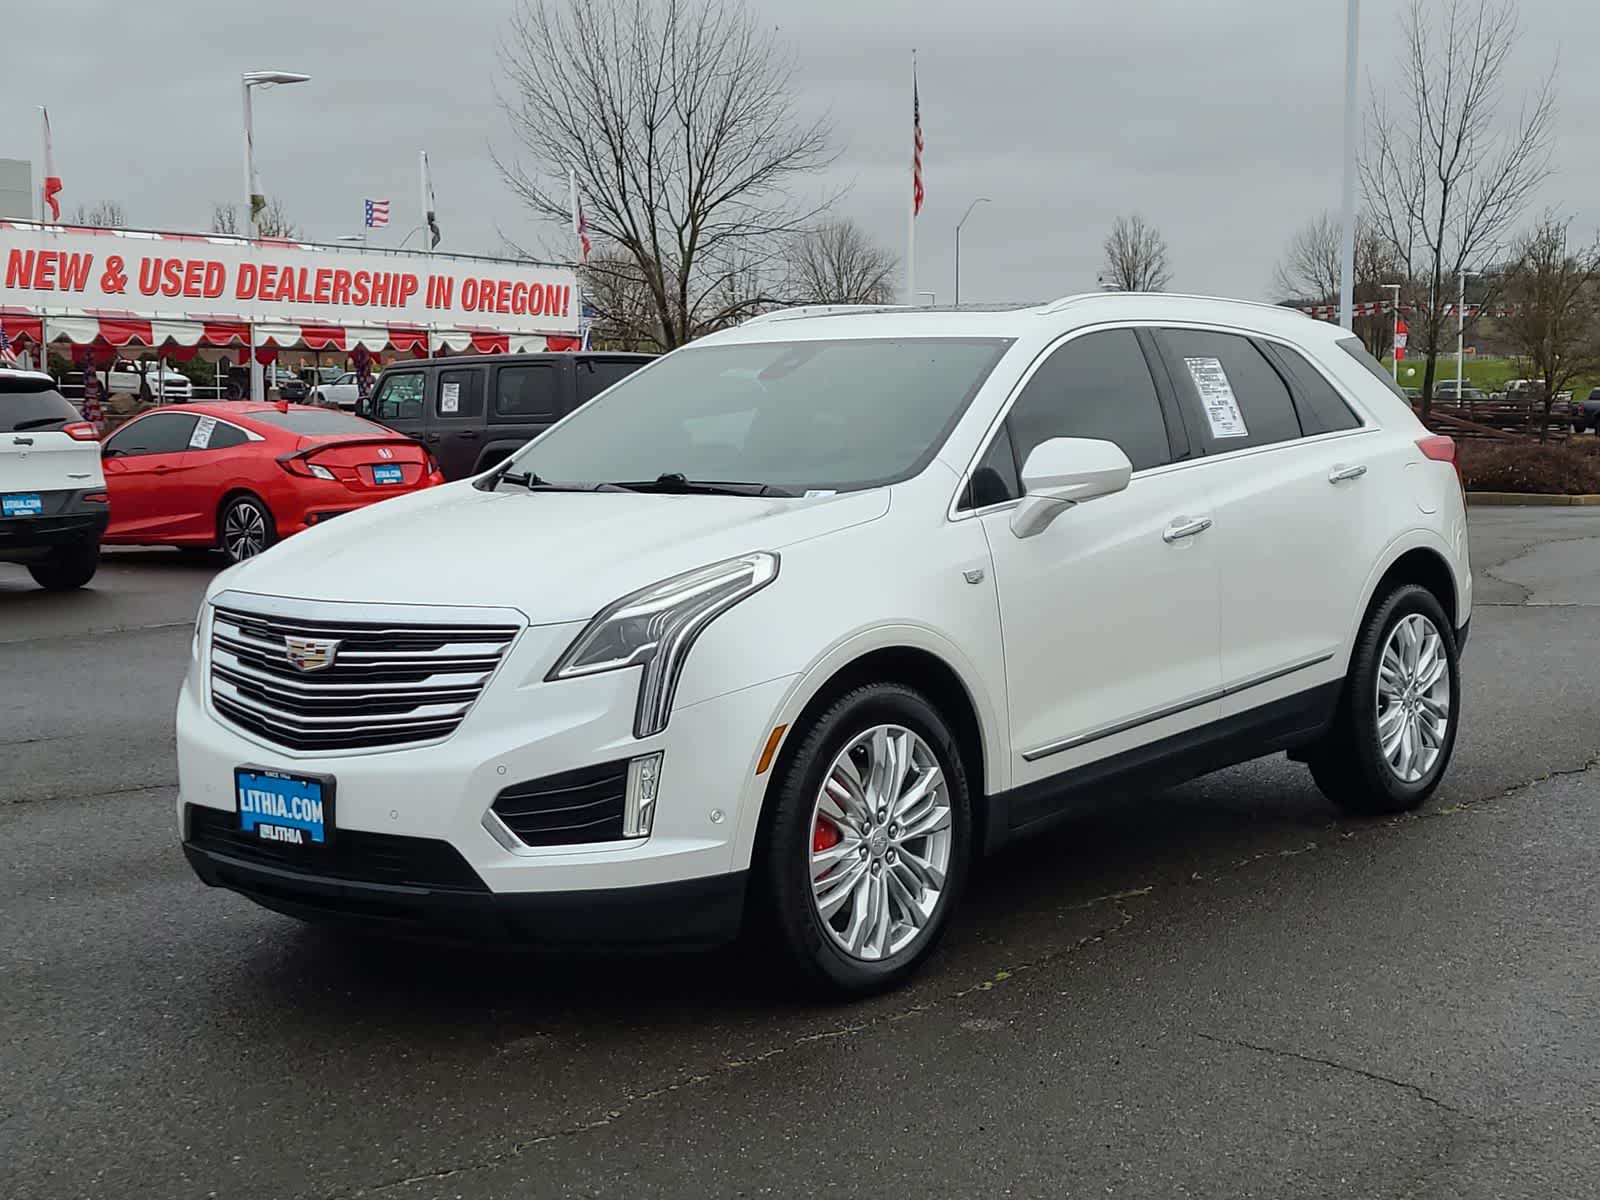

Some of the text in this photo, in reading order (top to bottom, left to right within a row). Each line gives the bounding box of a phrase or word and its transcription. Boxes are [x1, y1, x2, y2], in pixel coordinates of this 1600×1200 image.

[5, 248, 571, 318] NEW & USED DEALERSHIP IN OREGON!
[240, 788, 323, 824] LITHIA.COM
[271, 825, 303, 844] LITHIA
